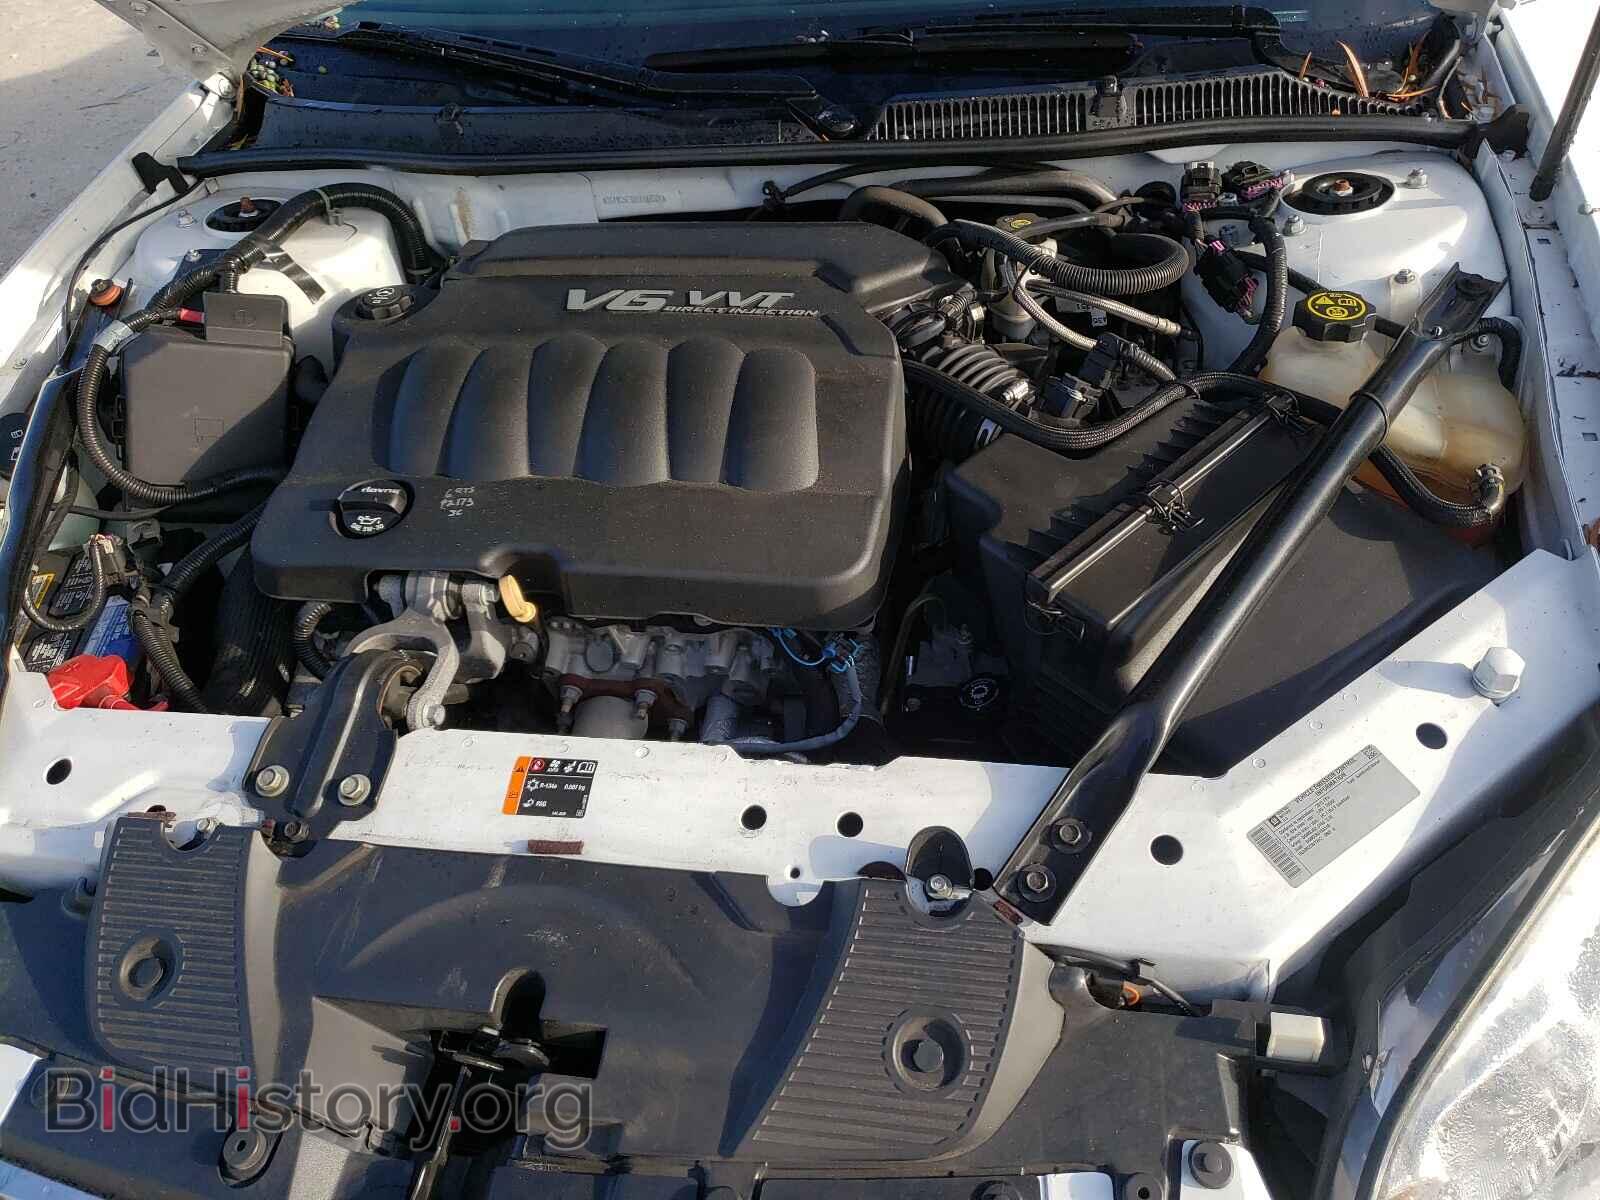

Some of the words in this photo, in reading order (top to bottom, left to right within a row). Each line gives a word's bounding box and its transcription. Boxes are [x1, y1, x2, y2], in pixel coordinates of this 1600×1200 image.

[567, 288, 675, 312] V6
[689, 290, 795, 308] VVT
[662, 305, 728, 314] DIRECT
[728, 307, 819, 317] INJECTION
